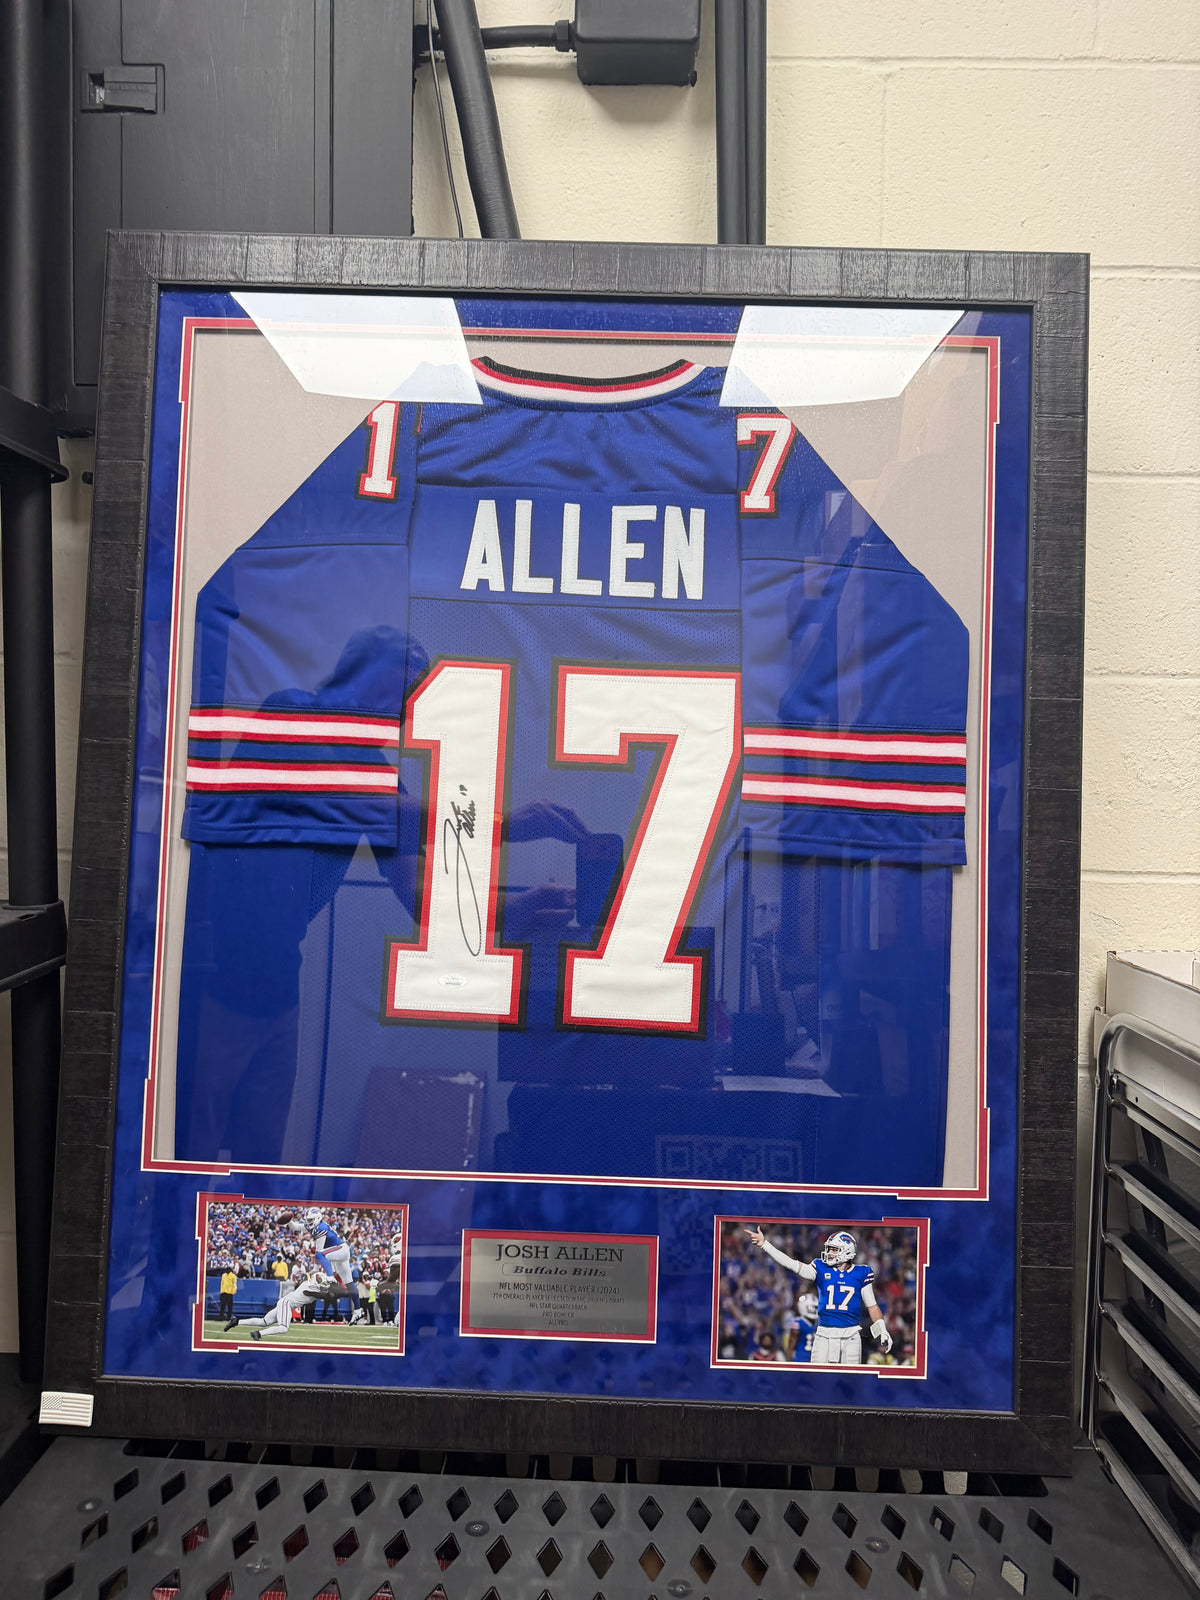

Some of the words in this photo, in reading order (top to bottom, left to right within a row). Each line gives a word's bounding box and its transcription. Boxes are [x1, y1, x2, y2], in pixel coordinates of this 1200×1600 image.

[460, 499, 706, 601] ALLEN
[384, 658, 743, 1033] 17
[495, 1243, 550, 1261] JOSH
[555, 1246, 624, 1262] ALLEN
[513, 1265, 568, 1276] Buffalo
[572, 1267, 606, 1277] Bills
[499, 1282, 511, 1291] NFL
[513, 1282, 533, 1292] MOST
[534, 1283, 568, 1293] VALUABLE
[569, 1284, 596, 1294] PLAYER
[826, 1284, 855, 1311] 17
